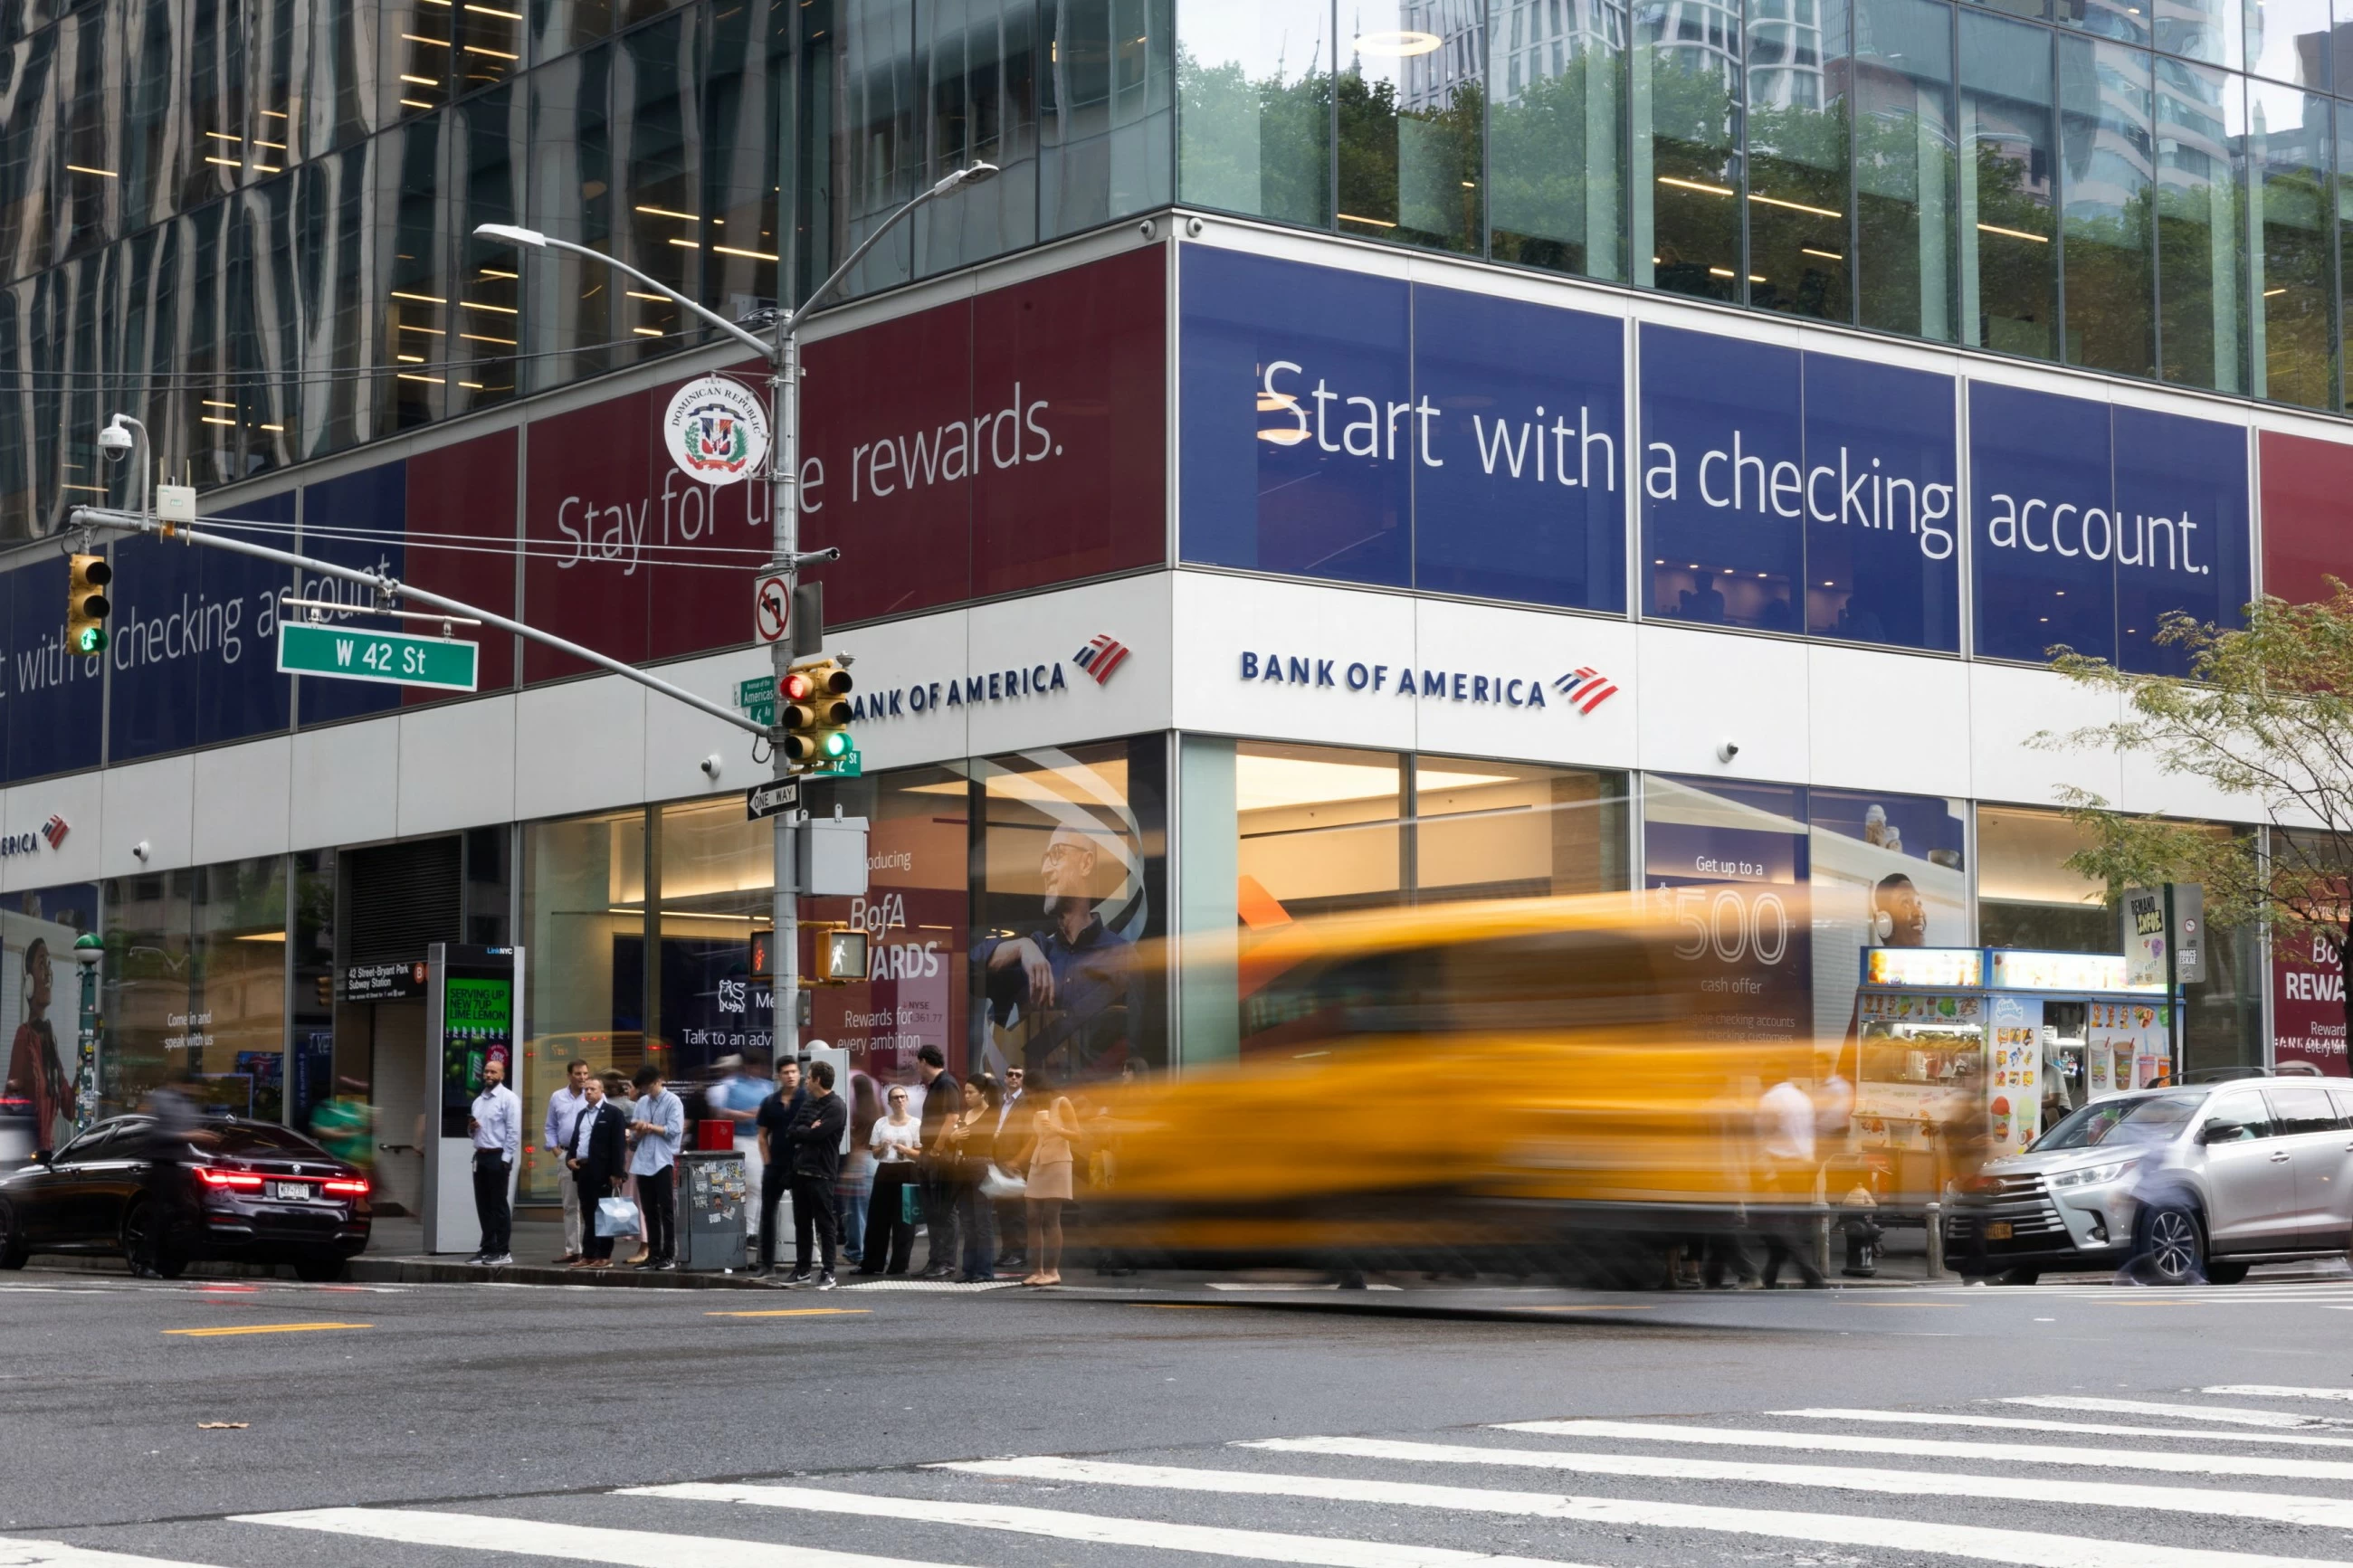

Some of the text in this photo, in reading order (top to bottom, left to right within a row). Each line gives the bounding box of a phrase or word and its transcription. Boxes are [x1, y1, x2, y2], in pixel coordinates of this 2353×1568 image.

[672, 386, 760, 433] DOMINICAN REPUBLIC
[1263, 361, 2209, 575] Start with a checking account.
[556, 381, 1063, 576] Stay for te rewards.
[115, 594, 243, 663] checking
[336, 639, 426, 675] W 42 St
[1242, 651, 1546, 708] BANK OF AMERICA
[743, 689, 774, 705] Americas
[847, 662, 1066, 721] ANK OF AMERICA
[849, 752, 857, 765] St
[754, 787, 793, 810] ONE WAY
[0, 832, 38, 856] ERICA
[866, 851, 911, 871] oducing
[1696, 856, 1763, 877] Get up to a
[850, 893, 906, 941] BofA
[1655, 881, 1788, 965] $500
[486, 947, 513, 955] LinkNYC
[869, 940, 939, 982] ARDS
[348, 964, 409, 979] 42 Street-Bryant Park
[348, 977, 392, 991] Subway Station
[449, 987, 505, 1000] SERVING UP
[1700, 977, 1763, 994] cash offer
[2285, 972, 2347, 1003] REWA
[449, 999, 491, 1011] NEW 7UP
[756, 992, 775, 1009] Me
[909, 1001, 929, 1011] NYSE
[167, 1010, 212, 1028] Come in and
[449, 1009, 506, 1021] LIME LEMON
[844, 1006, 913, 1030] Rewards for
[1715, 1012, 1754, 1029] checking
[1757, 1016, 1796, 1029] accounts
[682, 1029, 774, 1047] Talk to an advi
[1707, 1029, 1746, 1044] checking
[1748, 1032, 1794, 1044] customers
[2310, 1021, 2347, 1037] Reward
[164, 1032, 214, 1052] speak with us
[837, 1031, 920, 1057] every ambition
